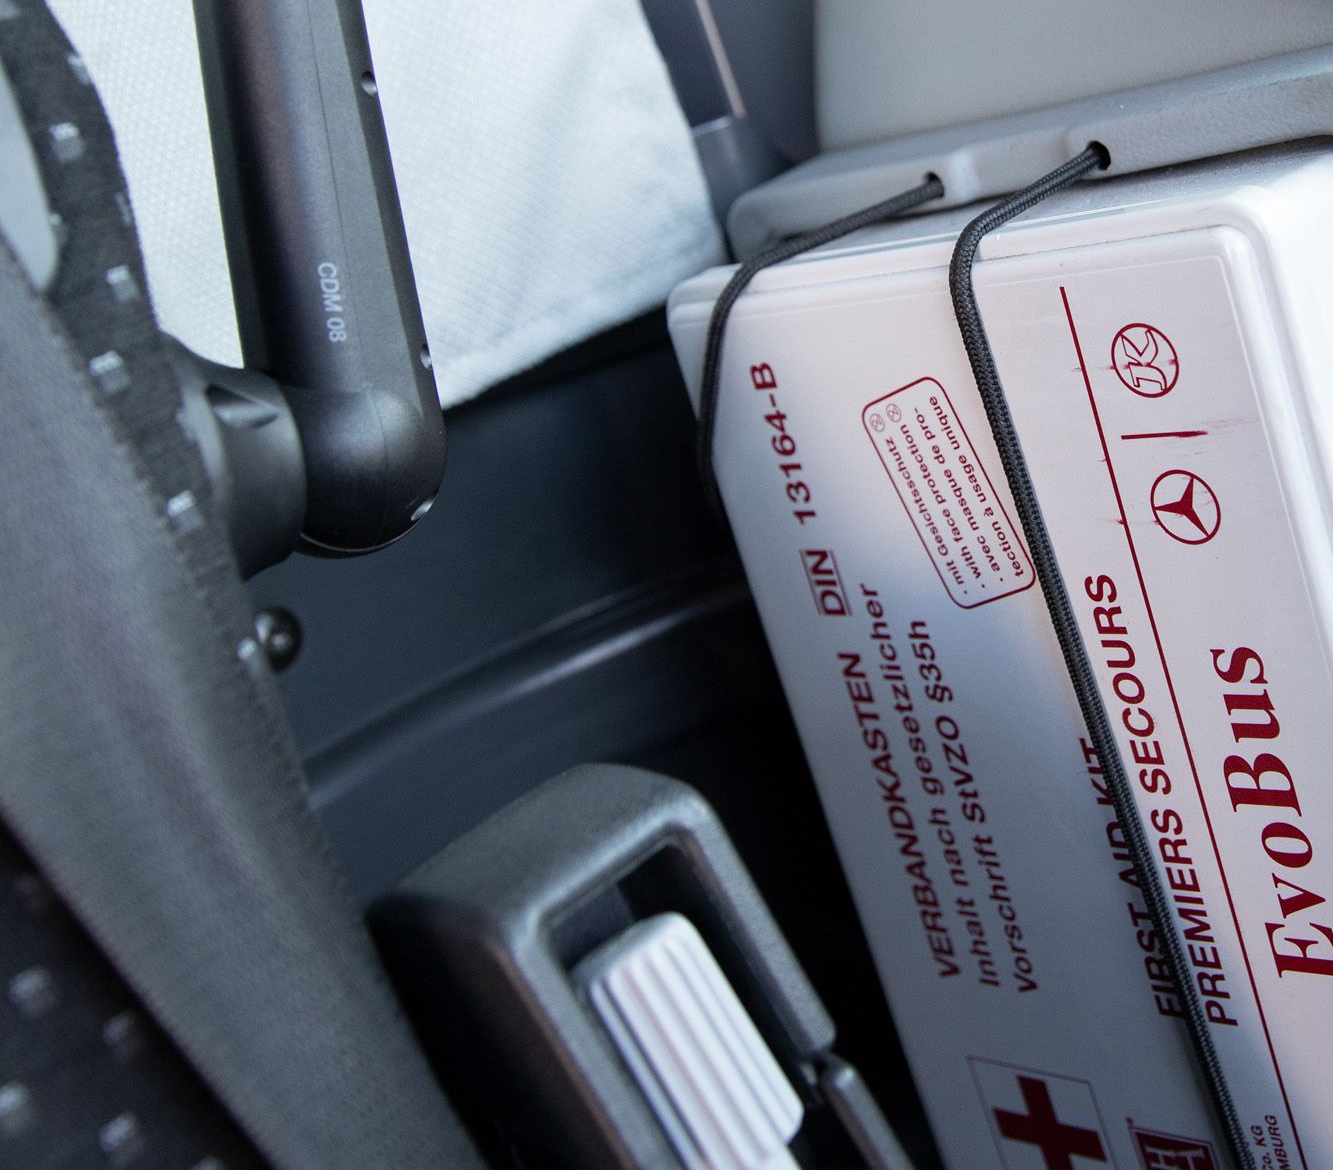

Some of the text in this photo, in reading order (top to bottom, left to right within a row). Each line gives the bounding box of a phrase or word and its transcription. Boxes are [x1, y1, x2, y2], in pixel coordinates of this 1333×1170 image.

[317, 262, 347, 342] CDM 08
[885, 436, 964, 586] mit Gesichtsschutz
[899, 424, 981, 579] with face protection
[914, 407, 1001, 572] avec masque de pro-
[929, 396, 1024, 577] tection à usage unique
[750, 361, 961, 979] VERBANDKASTEN DIN 13164-B
[860, 583, 1000, 988] Inhalt nach gesetzlicher
[907, 620, 1039, 993] Vorschrift StVZO §35h
[1084, 574, 1239, 1027] PREMIERS SECOURS
[1250, 1125, 1267, 1148] KG
